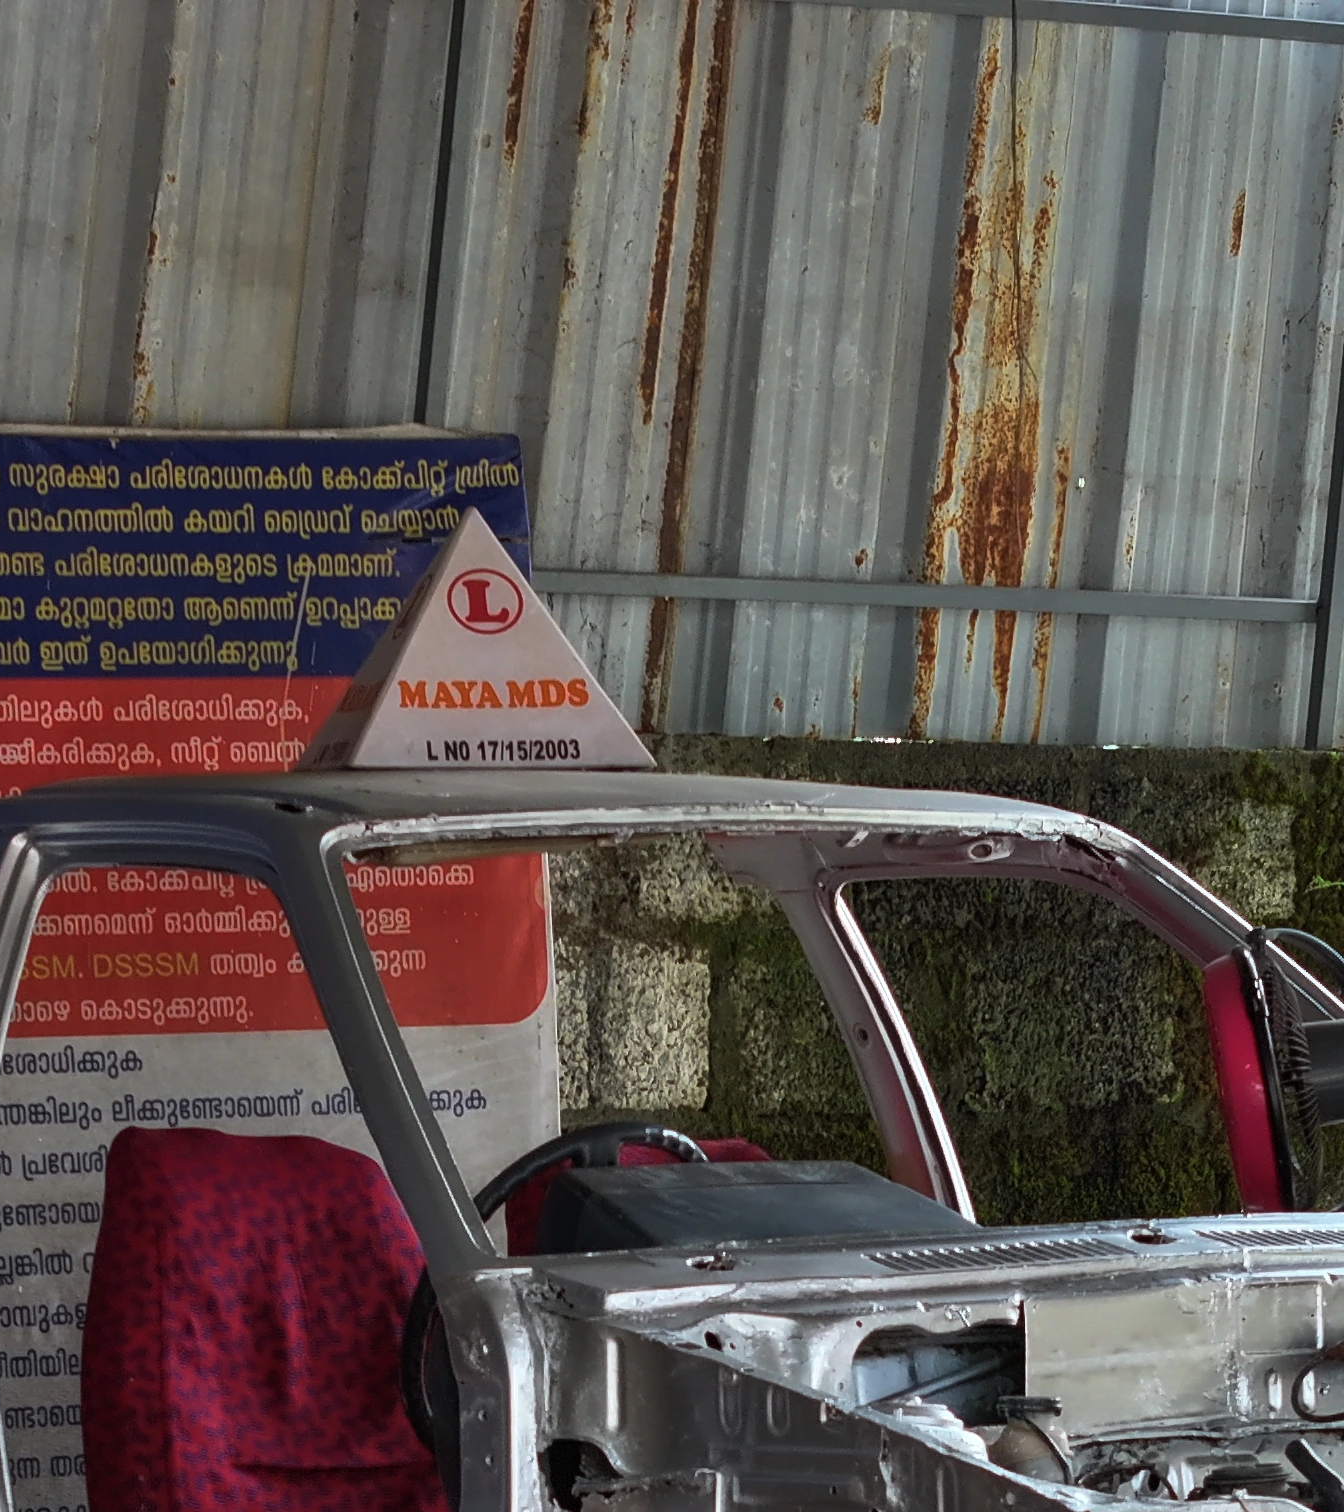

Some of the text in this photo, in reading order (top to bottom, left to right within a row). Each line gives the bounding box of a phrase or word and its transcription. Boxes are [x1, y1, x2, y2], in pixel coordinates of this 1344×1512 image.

[461, 578, 510, 624] L
[40, 634, 92, 671] ഇത്
[427, 741, 439, 761] L
[476, 739, 582, 761] 17/15/2003
[93, 952, 199, 978] DSSSM
